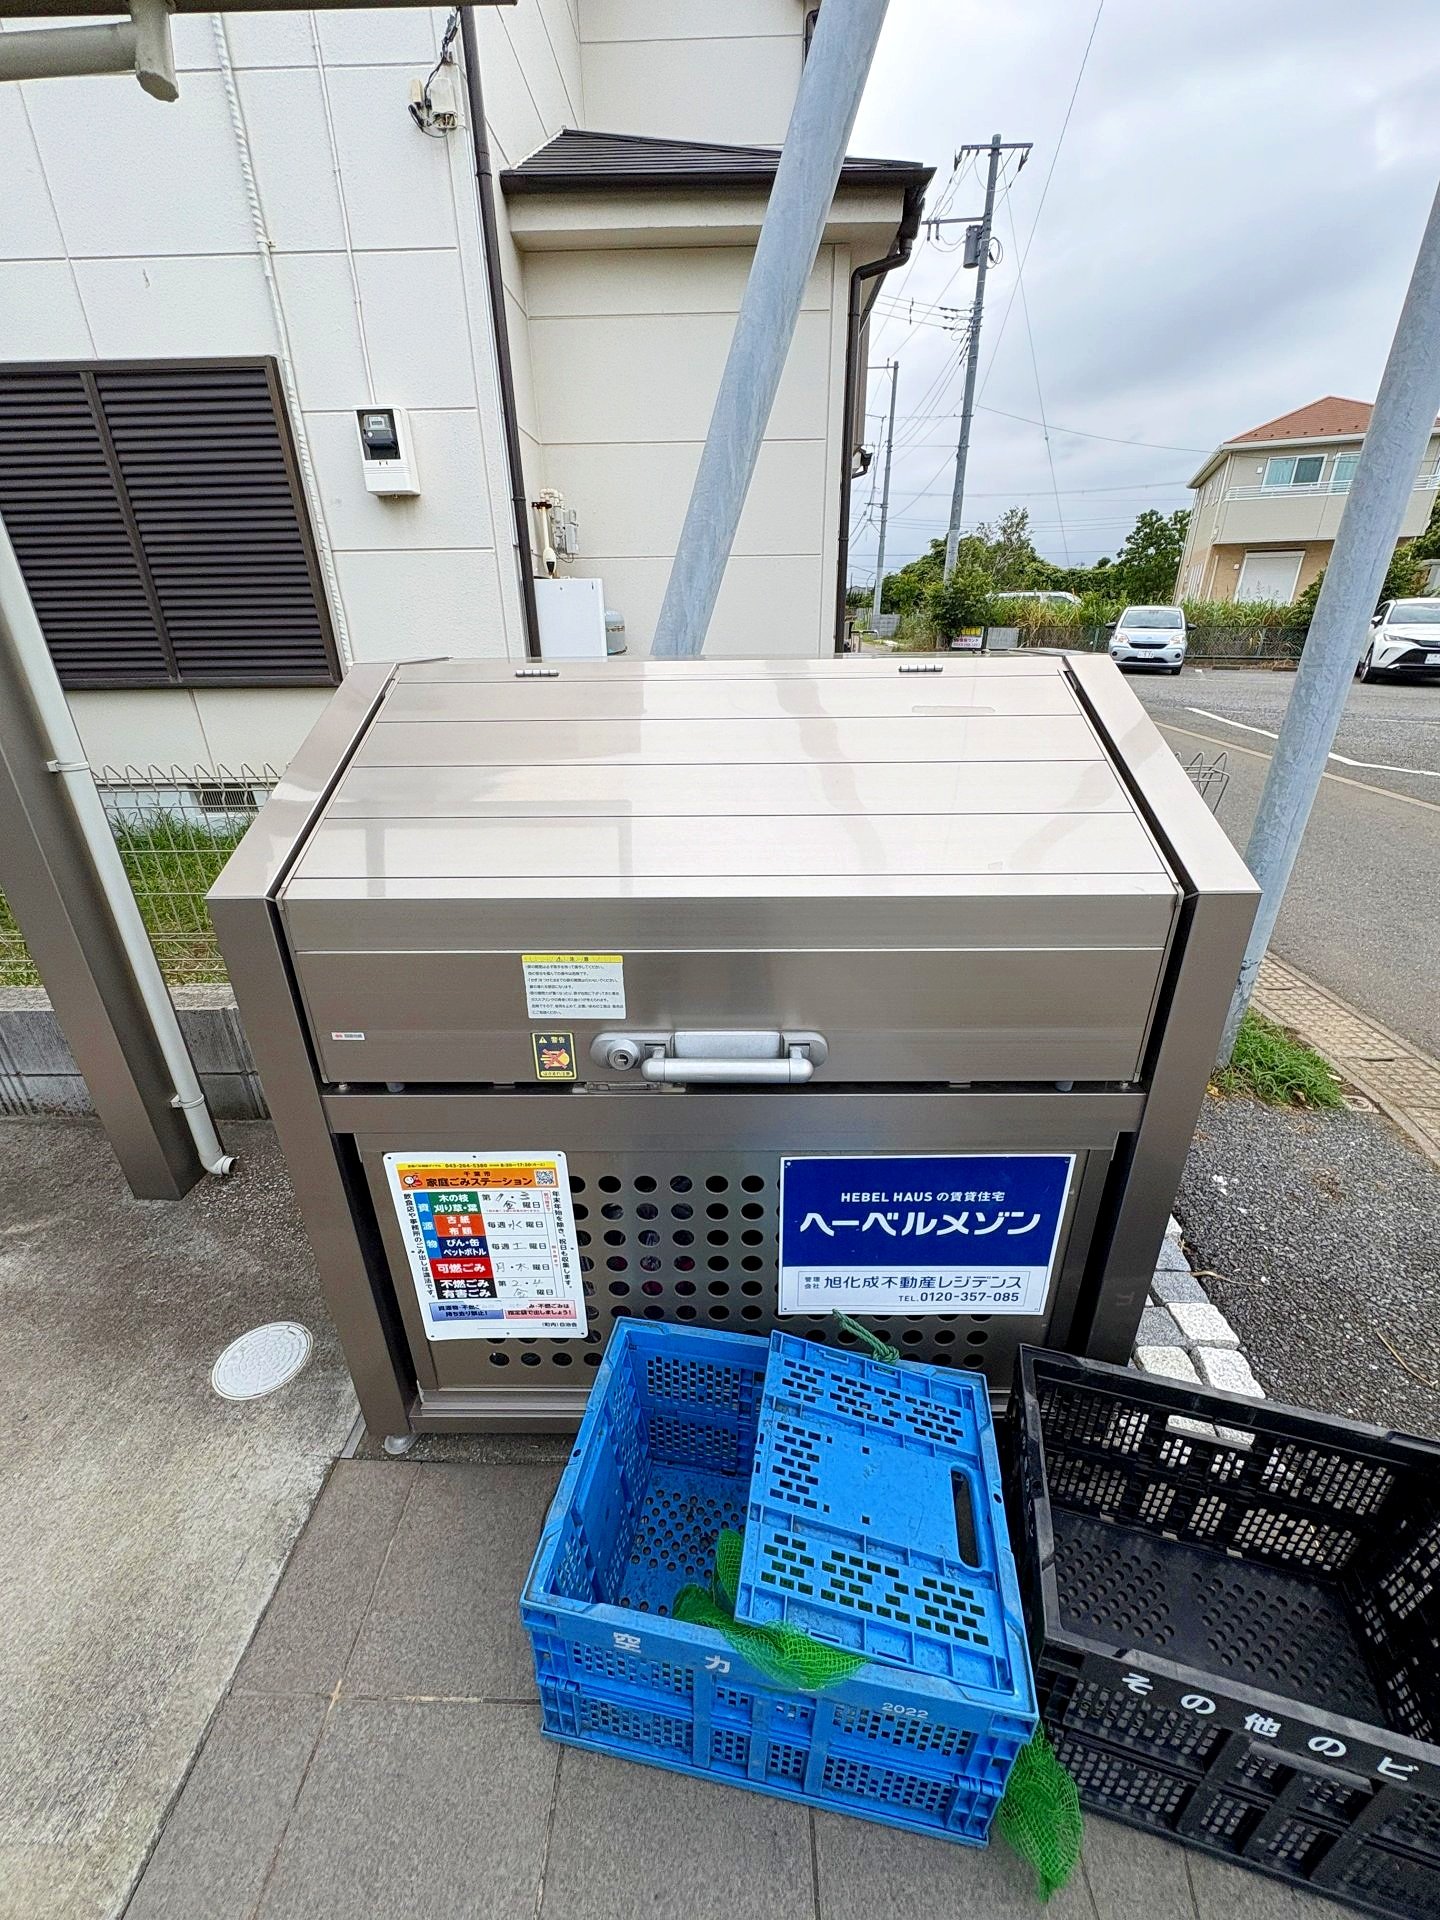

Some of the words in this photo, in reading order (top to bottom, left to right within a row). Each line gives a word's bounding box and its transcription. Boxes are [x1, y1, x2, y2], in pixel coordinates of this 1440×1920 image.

[550, 1036, 565, 1044] 警告
[426, 1177, 532, 1187] 家庭ごみステーション
[438, 1194, 469, 1203] 木の枝
[841, 1192, 890, 1203] HEBEL
[893, 1191, 933, 1203] HAUS
[936, 1191, 1006, 1202] の賃貸住宅
[800, 1211, 1041, 1237] ヘーベルメゾン
[443, 1248, 487, 1256] ペットボトル
[436, 1263, 486, 1274] 可燃ごみ
[440, 1280, 490, 1289] 不燃ごみ
[823, 1275, 1022, 1289] 旭化成不動産レジデンス
[882, 1702, 929, 1719] 2022
